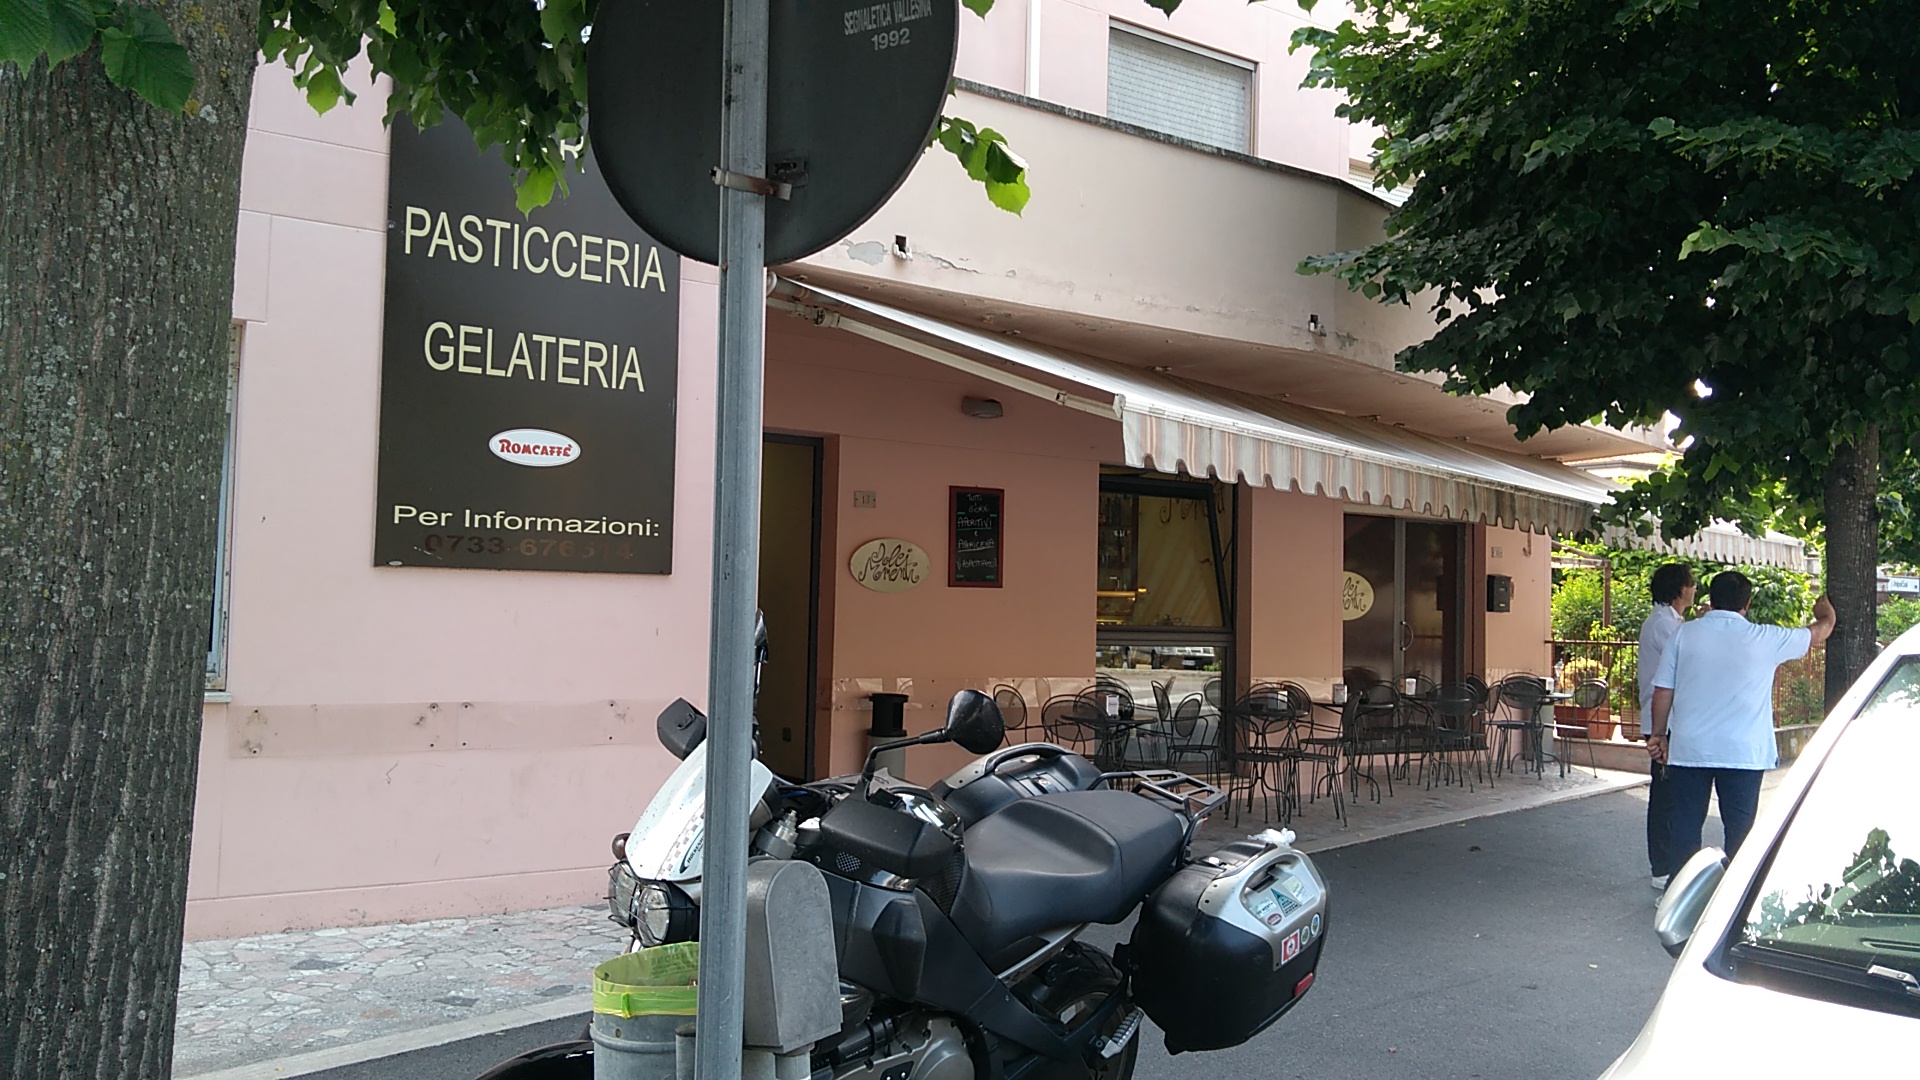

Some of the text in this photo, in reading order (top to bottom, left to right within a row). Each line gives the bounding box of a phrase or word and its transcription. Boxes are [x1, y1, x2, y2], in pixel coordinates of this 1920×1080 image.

[844, 3, 892, 36] SEGNALETICA
[871, 27, 911, 51] 1992
[404, 205, 666, 293] PASTICCERIA
[424, 321, 645, 393] GELATERIA
[862, 494, 870, 504] 13
[393, 505, 660, 537] Per Informazioni:
[957, 516, 992, 528] APERITIVI
[871, 542, 913, 568] Dolci
